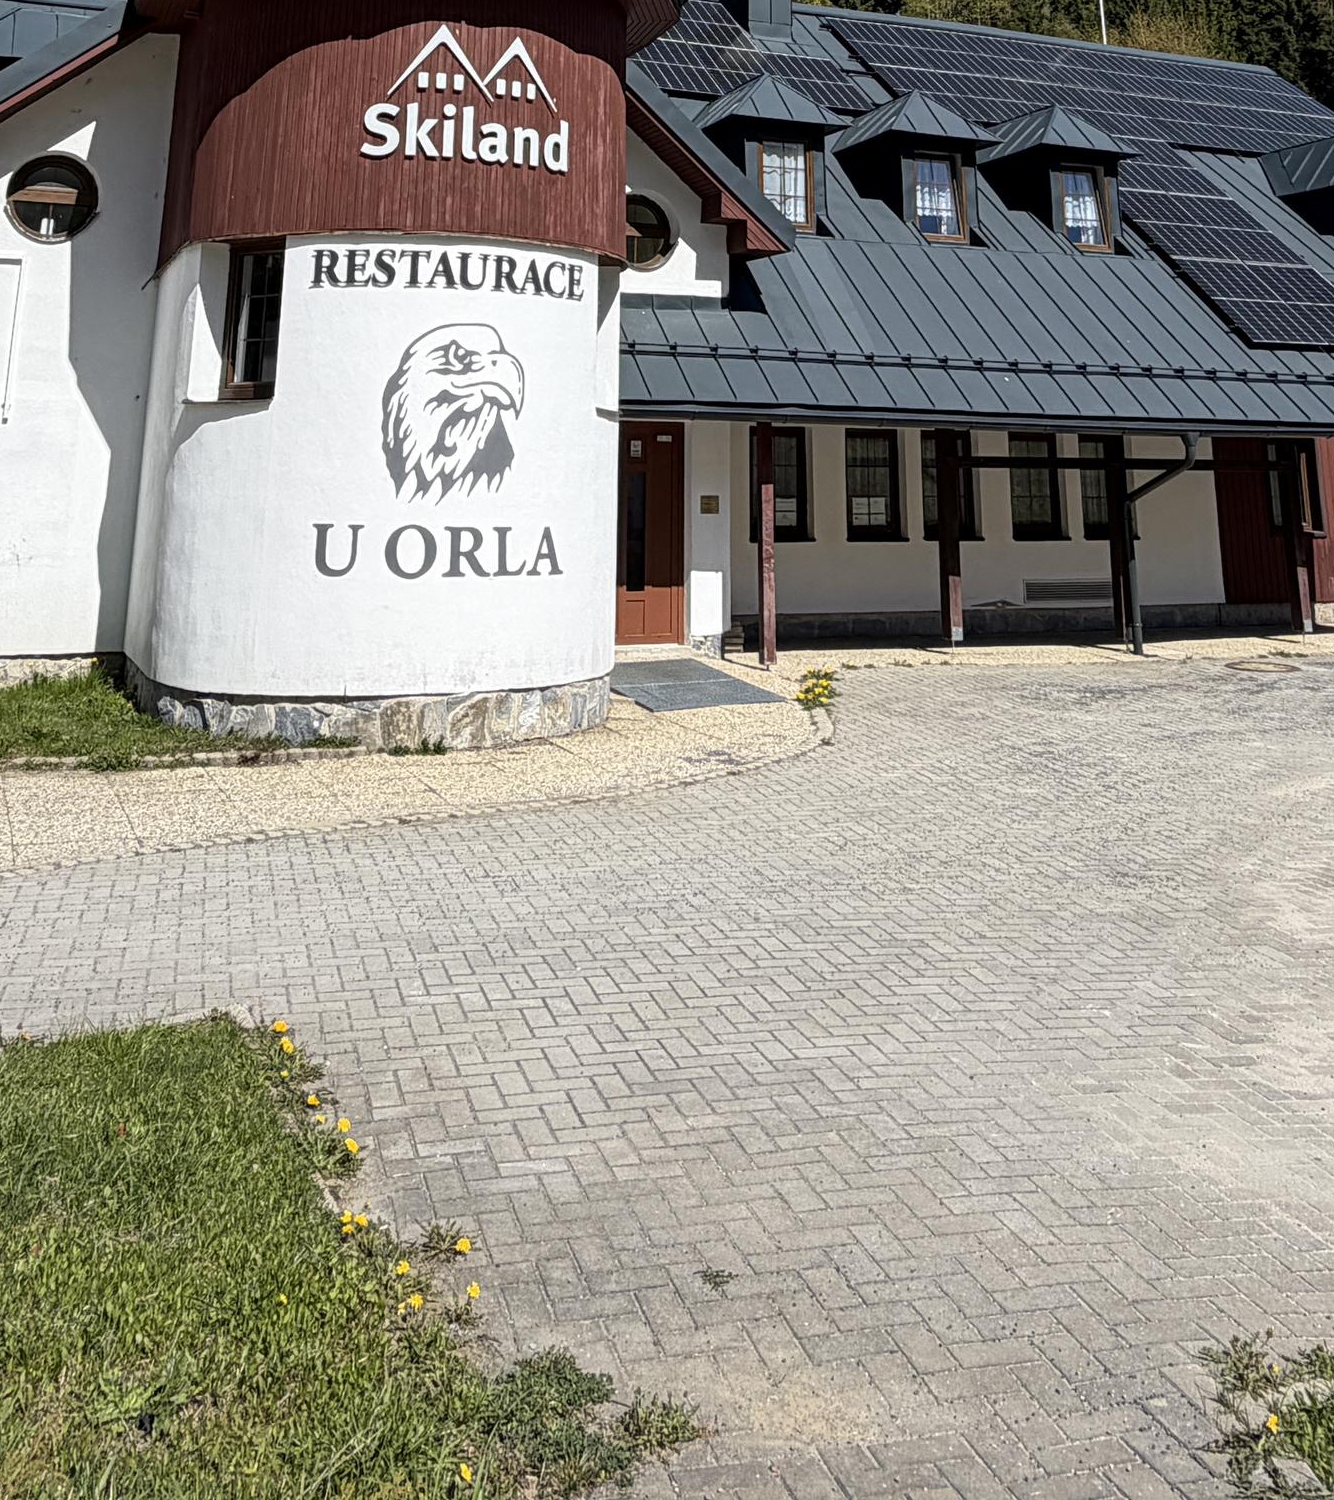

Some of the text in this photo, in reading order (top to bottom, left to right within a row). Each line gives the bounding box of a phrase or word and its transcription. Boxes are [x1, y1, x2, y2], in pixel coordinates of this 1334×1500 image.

[359, 102, 569, 174] Skiland
[308, 248, 585, 302] RESTAURACE
[312, 523, 564, 579] U ORLA
